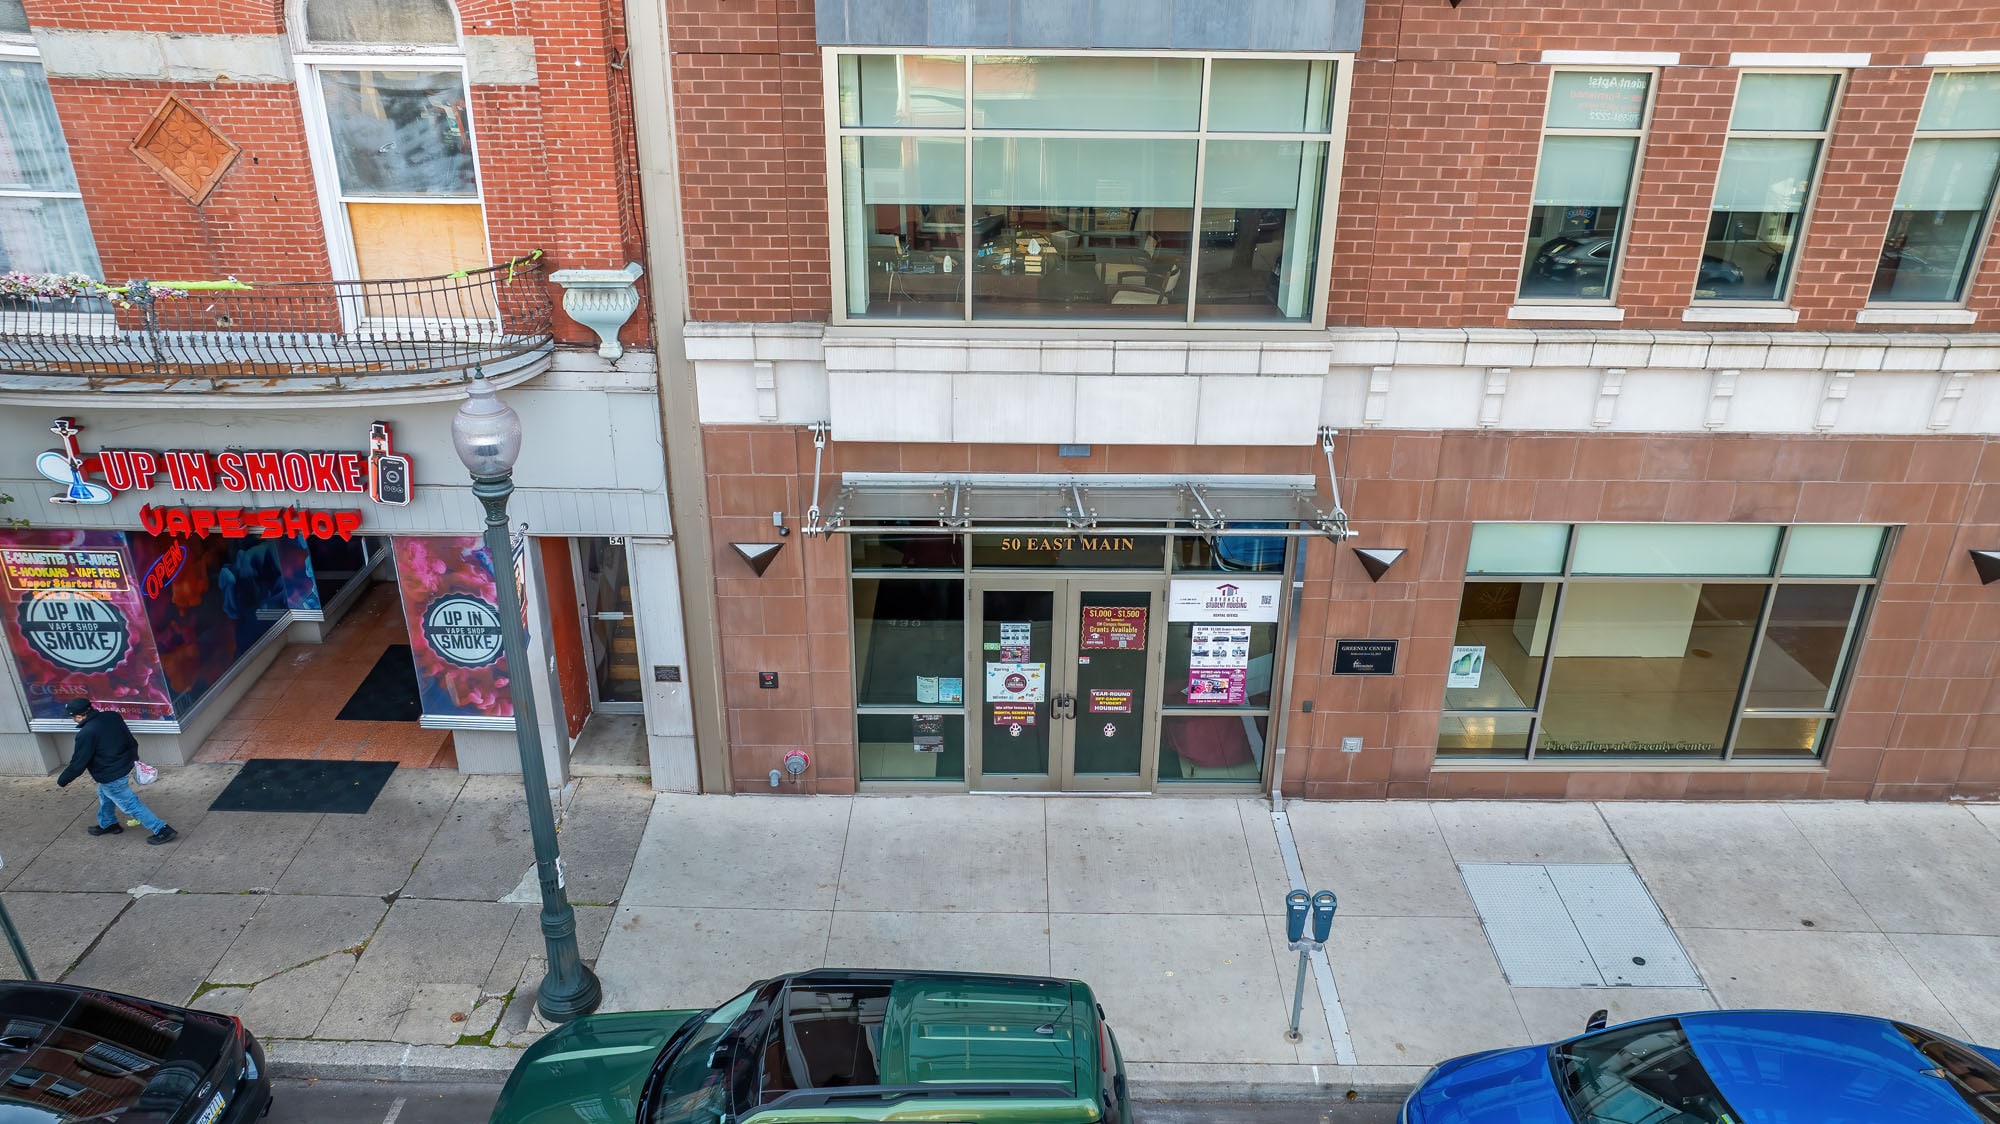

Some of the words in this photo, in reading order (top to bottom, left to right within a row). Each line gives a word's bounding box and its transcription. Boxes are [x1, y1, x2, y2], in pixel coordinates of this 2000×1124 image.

[100, 450, 158, 491] UP
[164, 451, 214, 492] IN
[217, 452, 364, 494] SMOKE
[139, 503, 248, 540] VAPE
[257, 505, 362, 542] SHOP
[611, 536, 624, 545] 54
[1001, 538, 1022, 551] 50
[1027, 538, 1076, 551] EAST
[1082, 538, 1135, 551] MAIN
[76, 552, 119, 566] E-JUICE
[9, 566, 70, 578] E-HOOKAHS
[75, 567, 98, 578] VAPE
[98, 568, 121, 579] PENS
[147, 538, 184, 600] OPEN
[53, 578, 92, 589] Starter
[94, 578, 118, 589] Kits
[42, 602, 69, 621] UP
[74, 603, 96, 621] IN
[1089, 609, 1112, 618] $1,000
[1117, 610, 1140, 618] $1,500
[443, 611, 462, 626] UP
[467, 611, 484, 626] IN
[49, 622, 74, 632] VAPE
[75, 622, 99, 632] SHOP
[445, 627, 467, 635] VAPE
[469, 627, 486, 635] SHOP
[43, 632, 114, 651] SMOKE
[441, 635, 494, 650] SMOKE
[29, 683, 89, 696] CIGARS
[1544, 740, 1567, 751] The
[1569, 740, 1611, 753] Gallery
[1613, 741, 1626, 751] at
[1629, 740, 1673, 753] Greenly
[1675, 740, 1713, 751] Center
